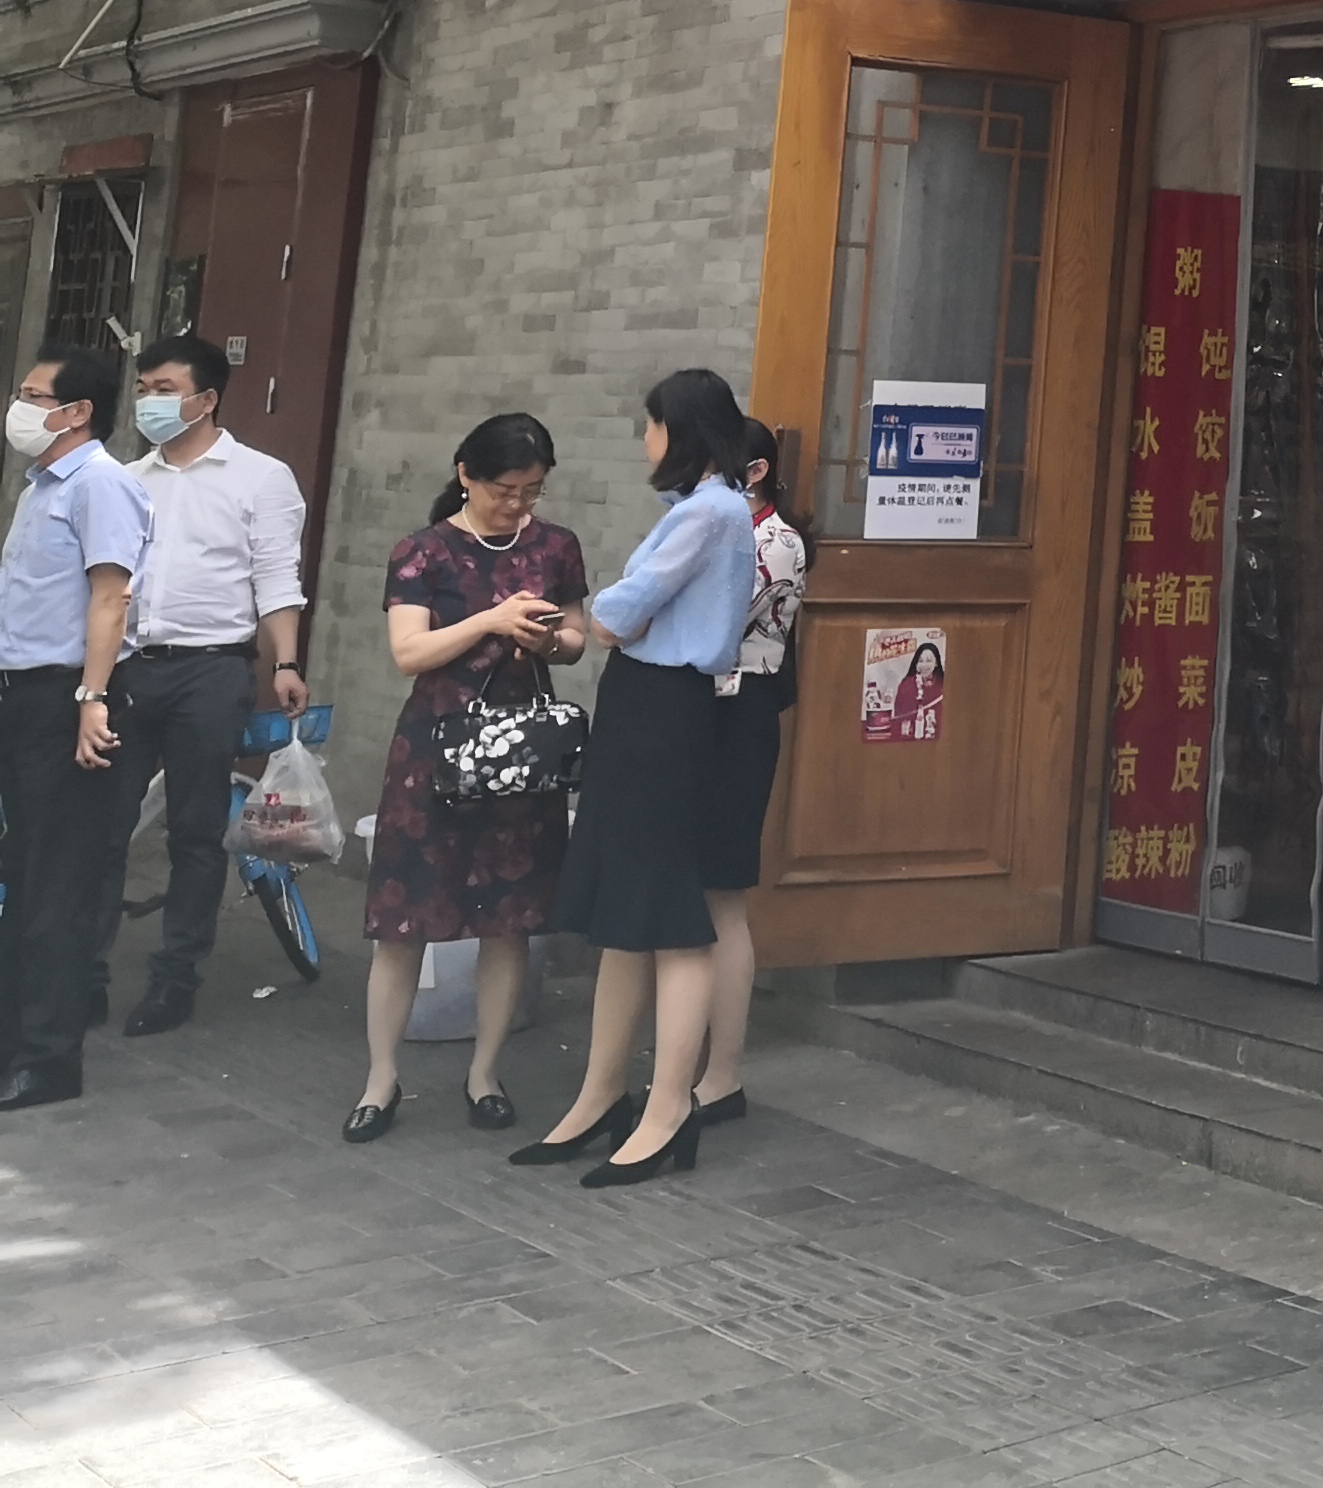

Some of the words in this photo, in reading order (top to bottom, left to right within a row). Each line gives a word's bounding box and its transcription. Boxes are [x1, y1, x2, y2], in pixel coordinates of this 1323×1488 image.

[1174, 247, 1202, 298] 粥
[1138, 324, 1231, 380] 馄饨
[1130, 406, 1227, 462] 水饺
[1125, 489, 1220, 543] 盖饭
[1119, 571, 1214, 627] 炸酱面
[1115, 654, 1210, 712] 炒菜
[1111, 737, 1203, 797] 凉皮
[1103, 823, 1197, 881] 酸辣粉
